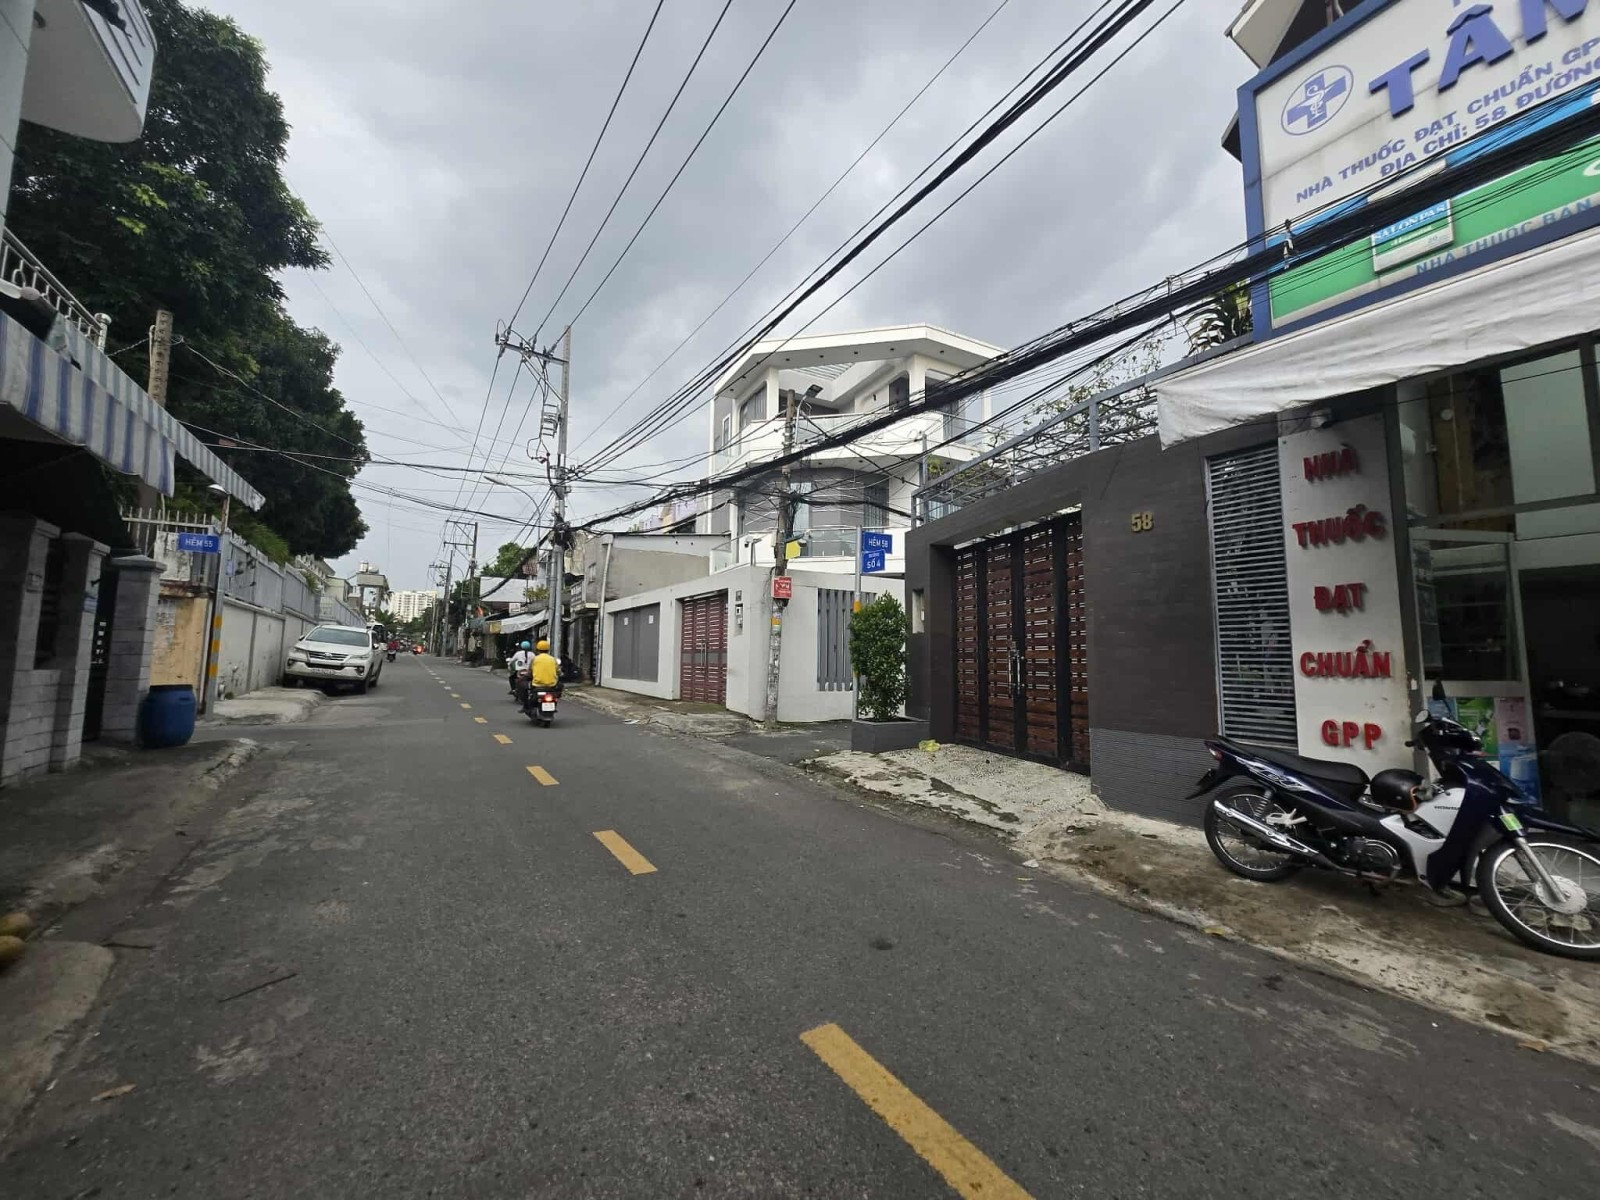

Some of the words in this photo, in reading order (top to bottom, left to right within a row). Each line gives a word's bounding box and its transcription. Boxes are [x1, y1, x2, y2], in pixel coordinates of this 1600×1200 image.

[1297, 175, 1333, 203] NHÀ
[1339, 139, 1406, 180] THUỐC
[1414, 111, 1457, 142] ĐẠT
[1467, 61, 1553, 115] CHUẨN
[1475, 105, 1507, 130] 58
[1303, 442, 1359, 481] NHÀ
[1131, 512, 1153, 532] 58
[1292, 504, 1387, 547] THUỐC
[1314, 582, 1365, 615] ĐẠT
[1300, 639, 1392, 678] CHUẨN
[1322, 719, 1382, 750] GPP
